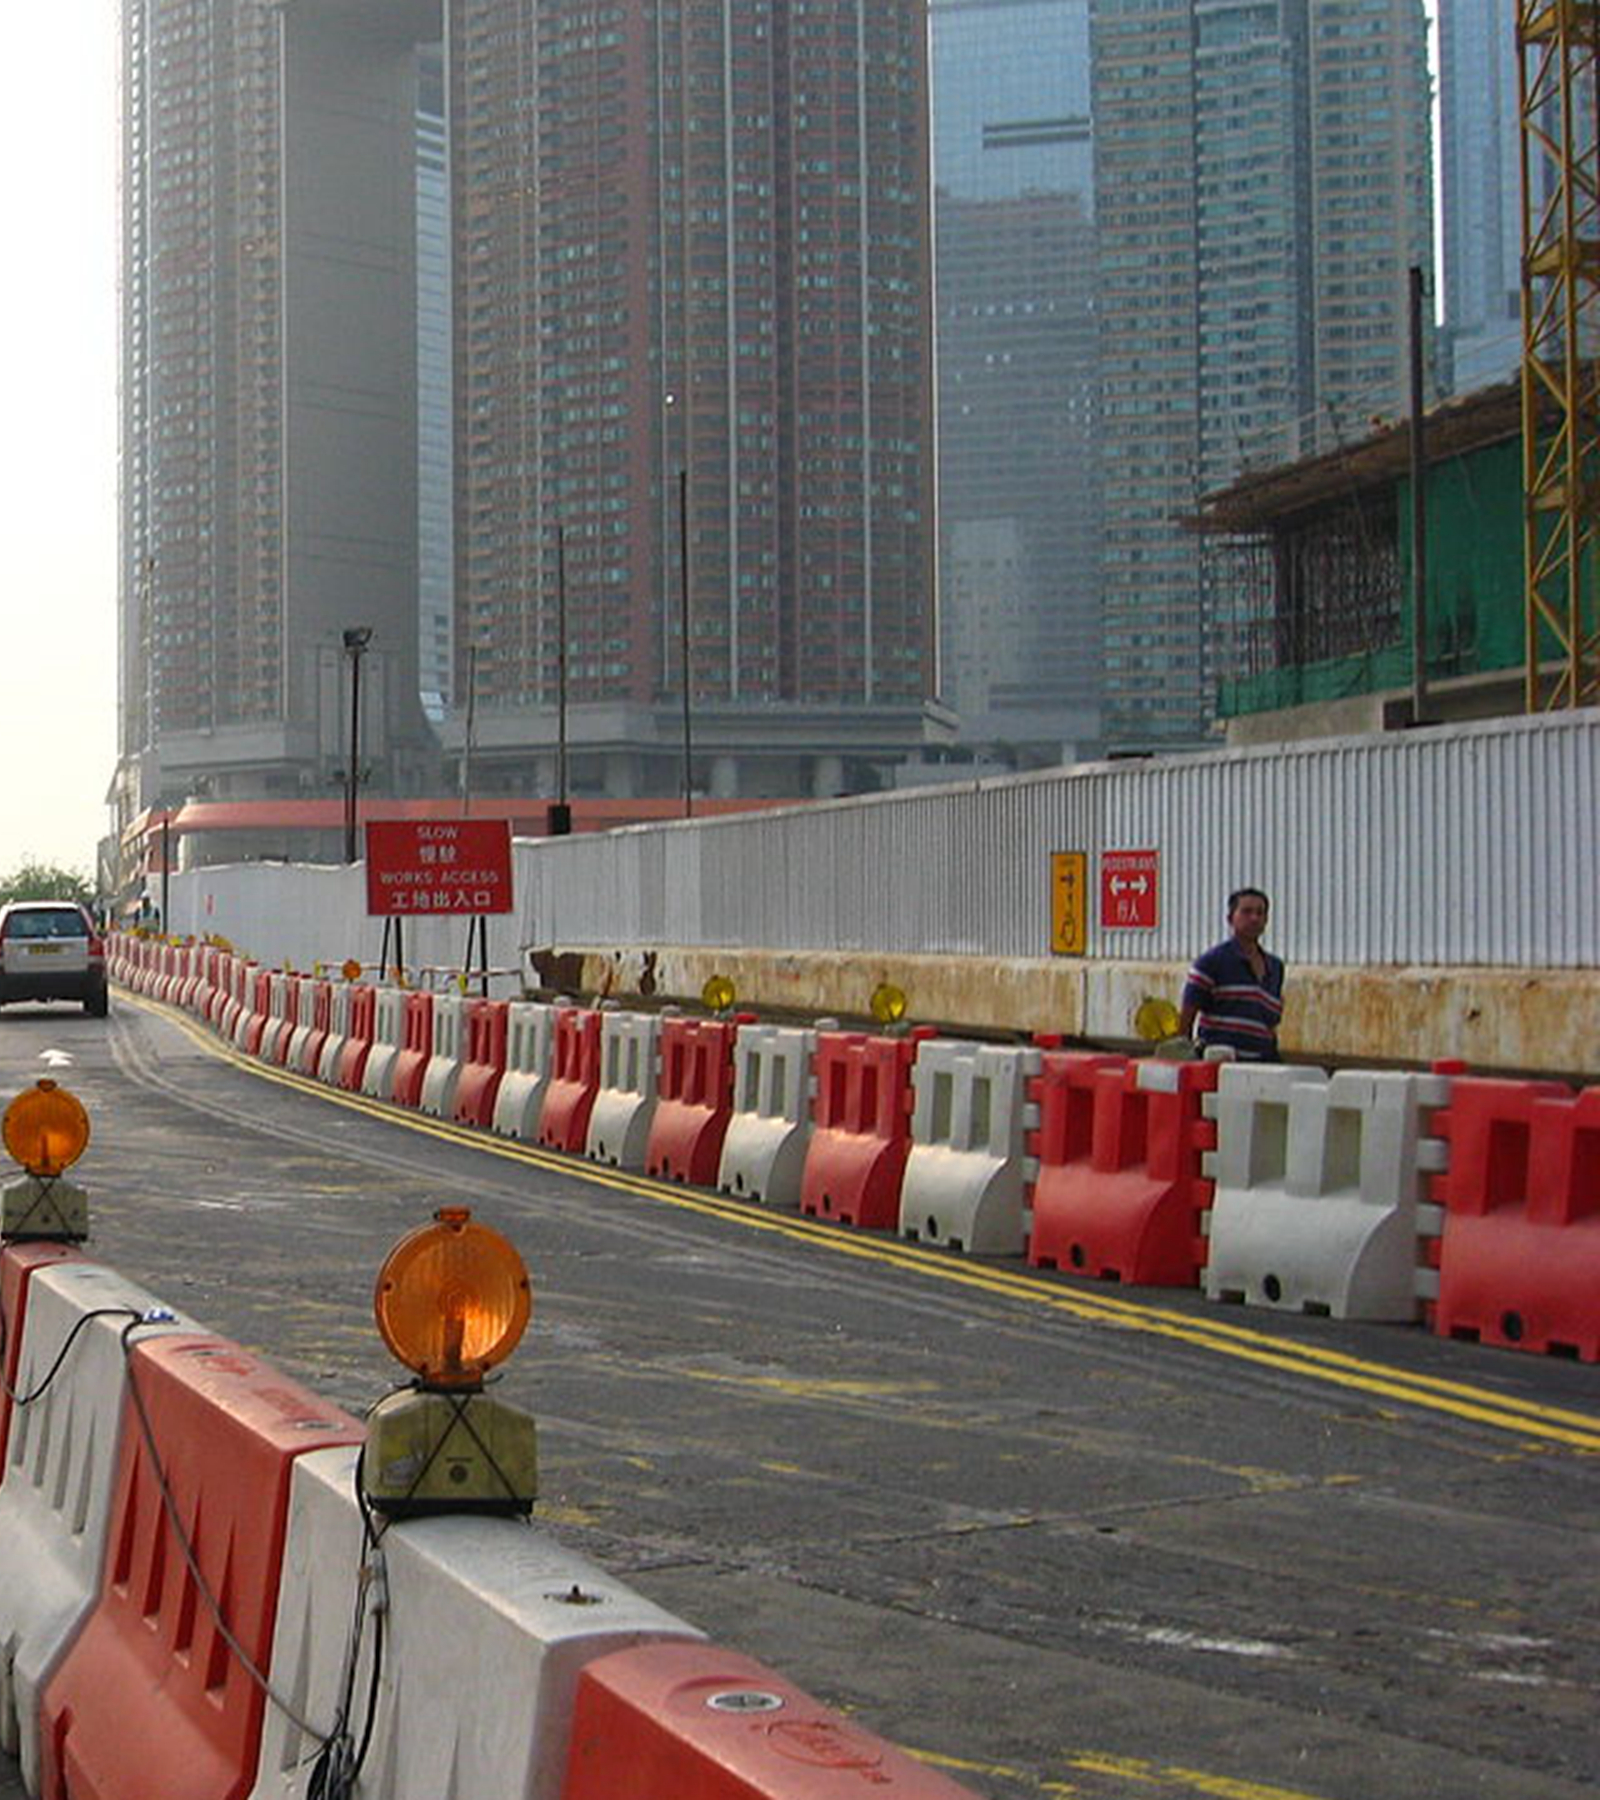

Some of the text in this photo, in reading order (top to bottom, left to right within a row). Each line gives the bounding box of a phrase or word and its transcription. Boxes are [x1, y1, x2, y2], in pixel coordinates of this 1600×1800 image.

[416, 825, 459, 839] SLOW
[380, 870, 498, 885] WORKS ACCESS
[391, 889, 491, 909] 工地出入口
